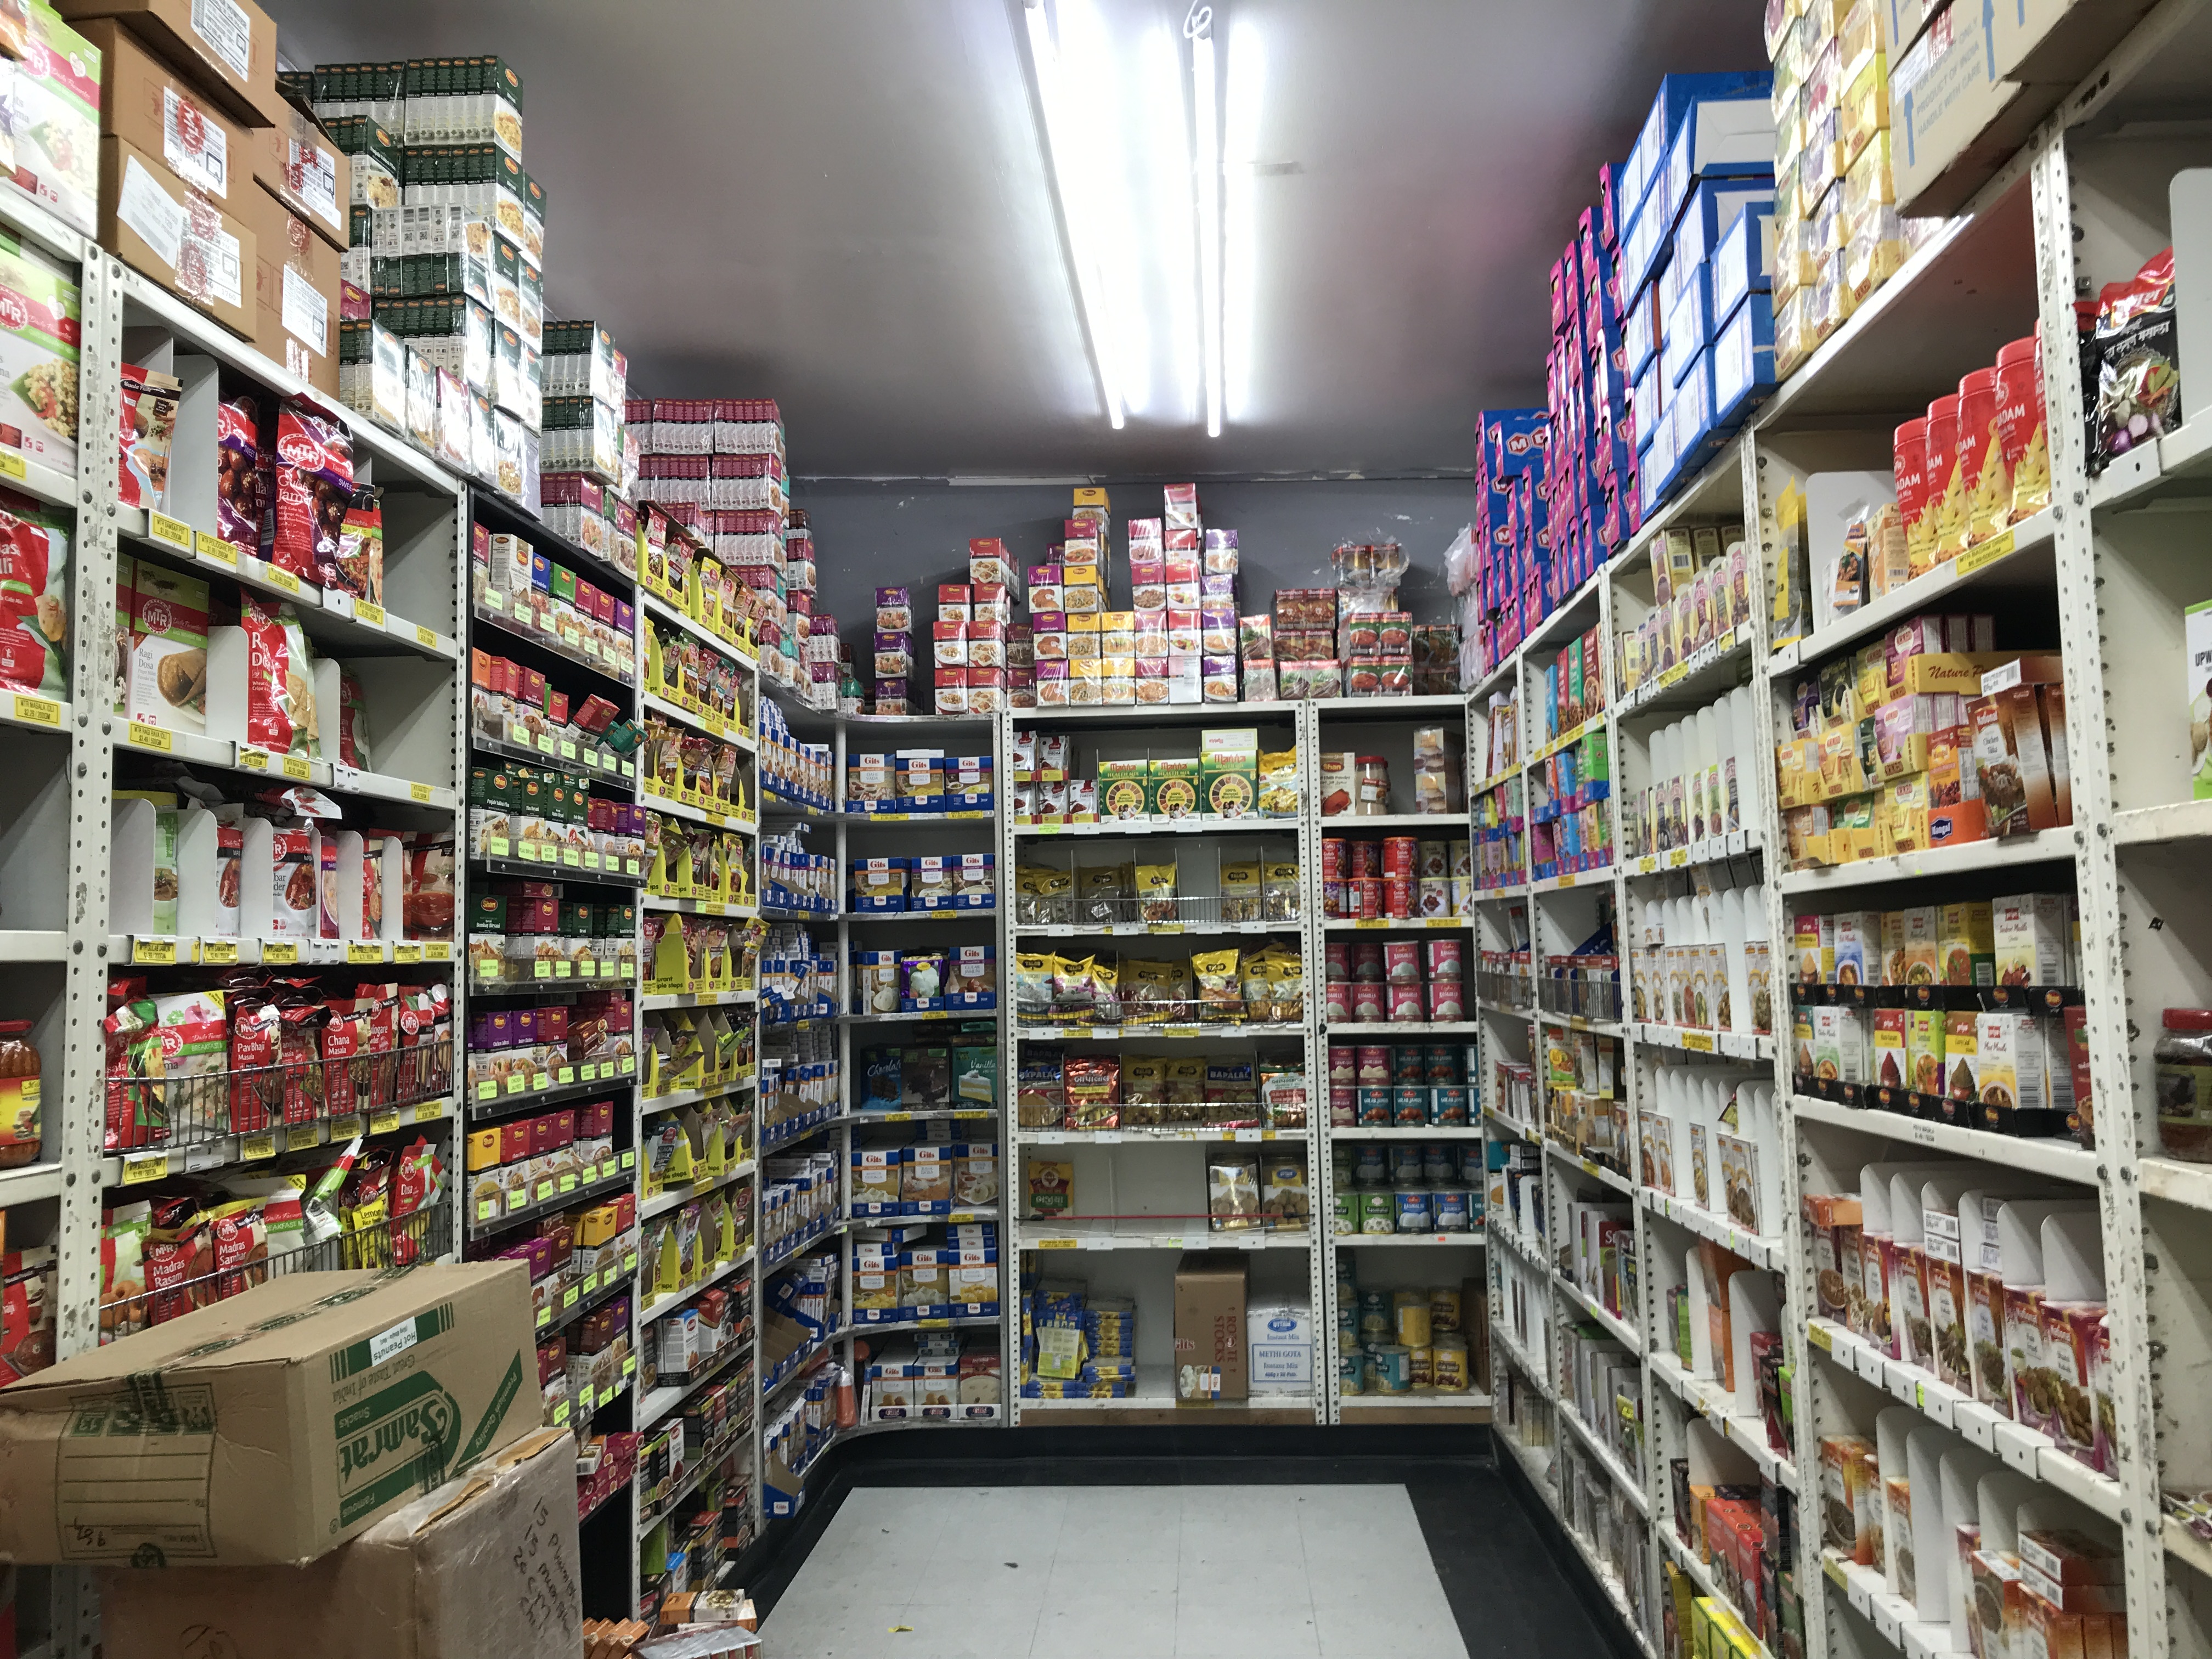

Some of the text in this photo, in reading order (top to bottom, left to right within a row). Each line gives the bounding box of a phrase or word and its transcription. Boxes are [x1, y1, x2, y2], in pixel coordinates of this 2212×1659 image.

[1917, 41, 1979, 117] PRODUCT OF INDIA
[1918, 61, 1981, 137] HANDLE WITH CARE
[286, 443, 320, 466] MTR
[338, 478, 353, 492] SWEE
[147, 608, 167, 627] MTR
[139, 647, 154, 661] Ragi
[138, 658, 154, 670] Dosa
[1928, 665, 1970, 679] Nature
[865, 757, 880, 765] Gits
[1214, 754, 1246, 764] Manna
[1110, 763, 1136, 771] Manna
[1161, 761, 1187, 770] Manna
[870, 860, 886, 870] Gits
[924, 859, 939, 867] Gits
[274, 874, 286, 883] bar
[274, 882, 286, 891] der
[964, 949, 980, 957] Gits
[405, 1017, 417, 1028] MTR
[328, 1035, 350, 1046] Chana
[237, 1041, 266, 1053] Pav Bhaji
[328, 1047, 347, 1056] Masala
[970, 1059, 996, 1069] Vanilla
[1210, 1071, 1249, 1079] BAPALAL
[919, 1150, 935, 1159] Gits
[972, 1147, 988, 1155] Gits
[866, 1155, 882, 1163] Gits
[360, 1209, 381, 1219] Lemon
[222, 1224, 235, 1233] MTR
[267, 1220, 298, 1233] EAKFAST
[156, 1245, 173, 1255] MTR
[219, 1242, 246, 1254] Madras
[219, 1252, 247, 1266] Sambar
[864, 1260, 880, 1268] Gits
[916, 1254, 932, 1262] Gits
[154, 1259, 185, 1277] Madras
[155, 1273, 182, 1288] Rasam
[405, 1331, 417, 1346] Hot
[1214, 1316, 1226, 1363] STOCKS
[373, 1338, 403, 1361] Peanuts
[332, 1353, 416, 1404] Great Taste of India
[494, 1371, 518, 1415] Premium
[338, 1406, 371, 1429] Snacks
[475, 1414, 496, 1449] Quality
[338, 1398, 448, 1485] Samrat
[342, 1492, 376, 1516] Famous
